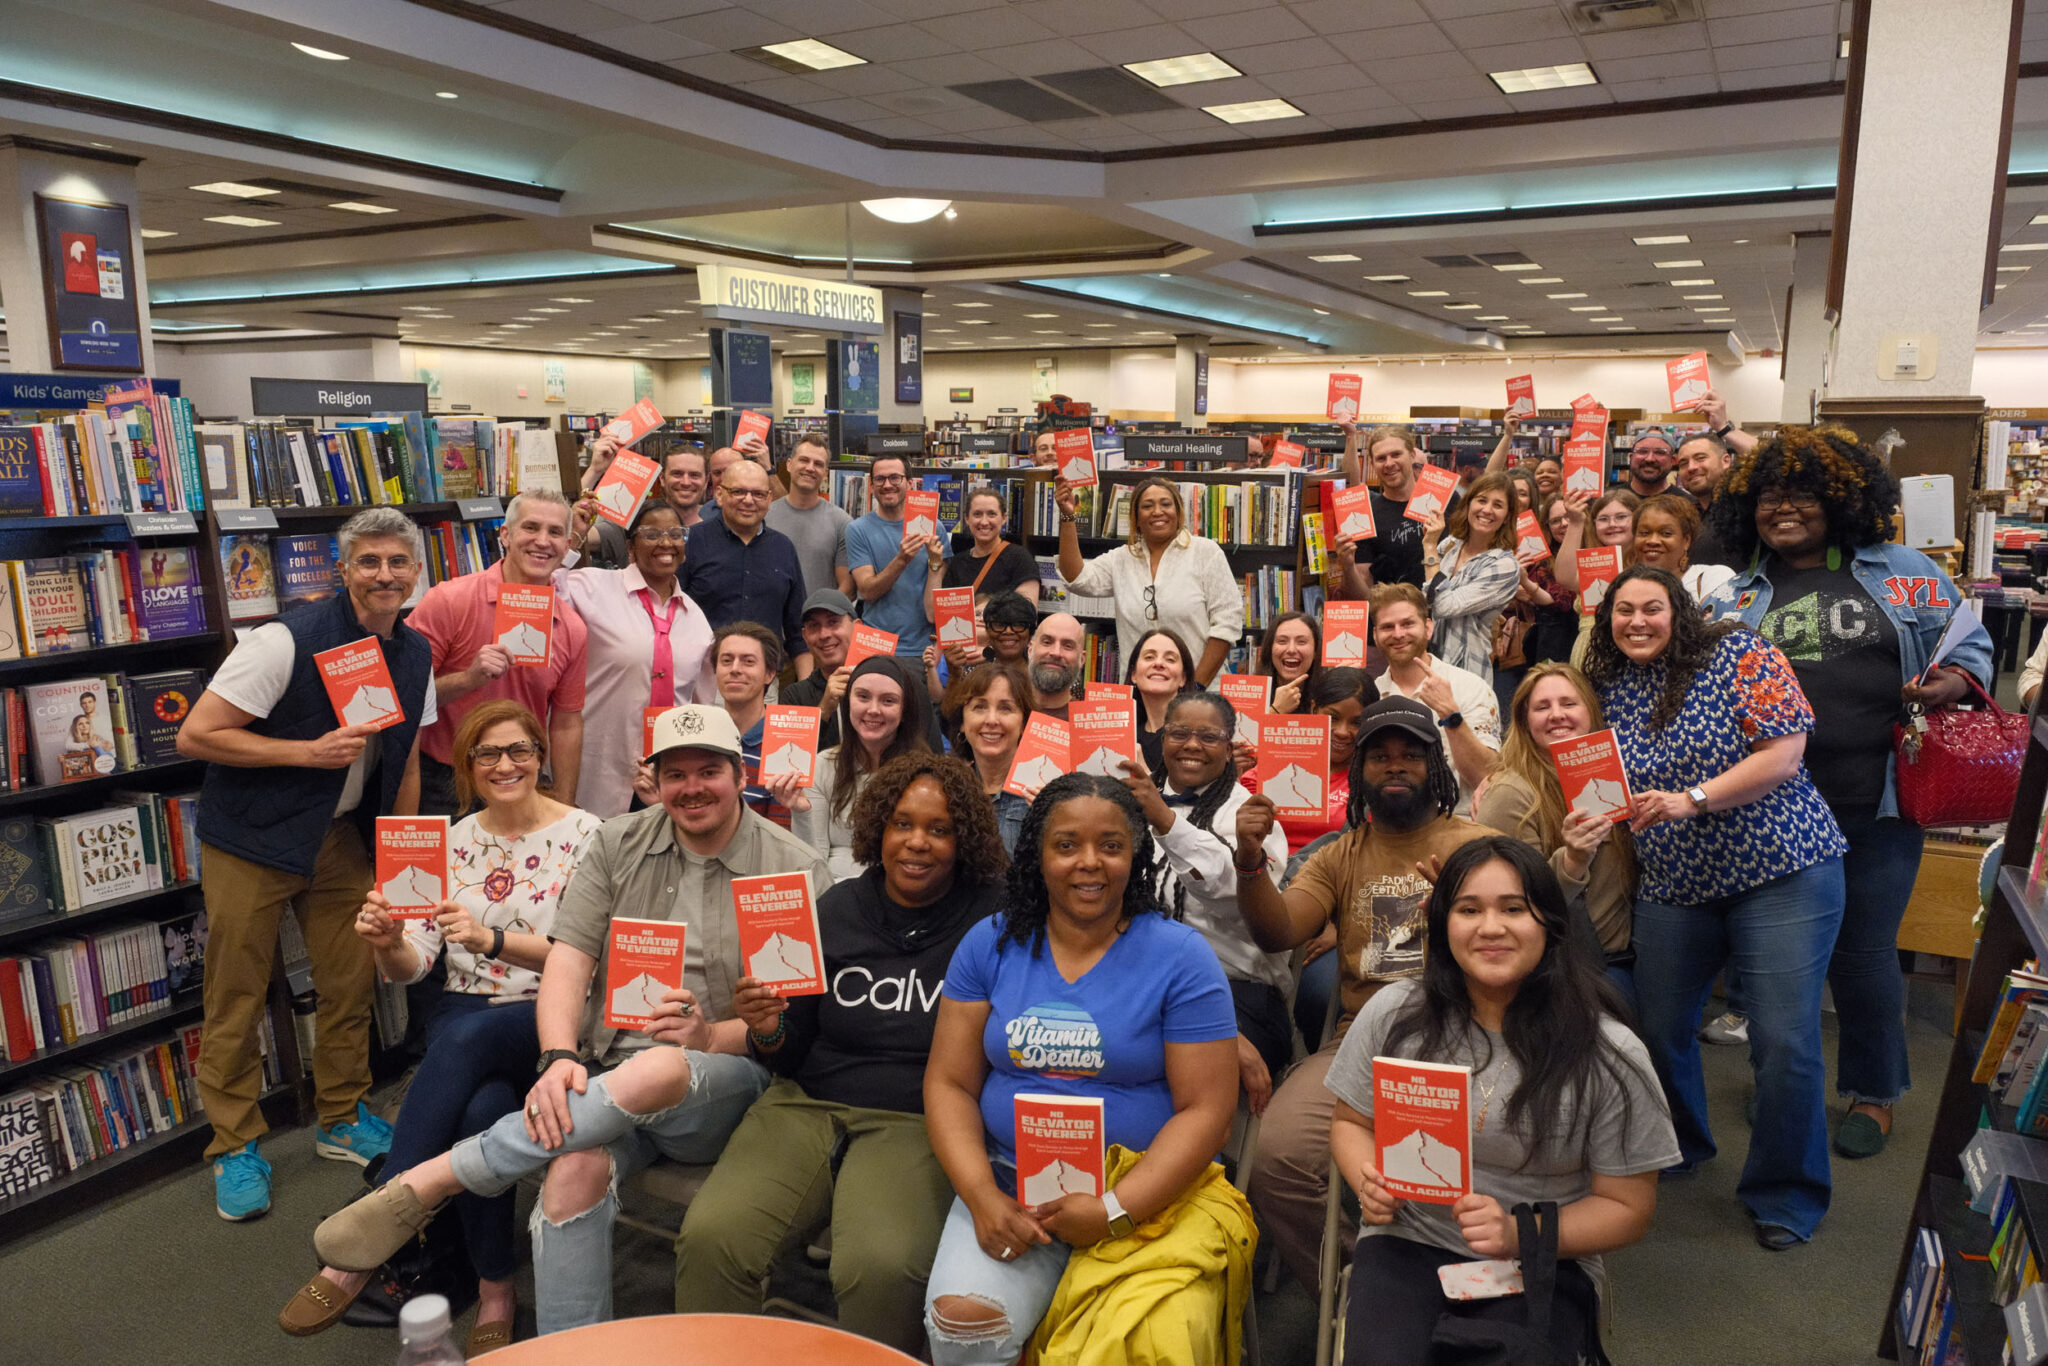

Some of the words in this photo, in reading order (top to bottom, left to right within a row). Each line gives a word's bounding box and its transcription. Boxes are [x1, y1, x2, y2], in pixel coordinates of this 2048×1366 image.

[729, 276, 809, 315] CUSTOMER
[814, 289, 875, 323] SERVICES
[13, 384, 49, 398] Kids'
[52, 386, 103, 400] Games
[317, 390, 372, 408] Religion
[1991, 410, 2028, 418] ADERS
[883, 439, 909, 447] Cookbooks
[1148, 443, 1183, 453] Natural
[1186, 444, 1223, 456] Healing
[940, 512, 958, 520] SLEEP
[292, 541, 318, 552] VOICE
[289, 556, 307, 568] FOR
[308, 555, 324, 566] THE
[55, 576, 73, 584] LIFE
[286, 570, 332, 584] VOICELESS
[50, 585, 74, 593] YOUR
[150, 586, 188, 602] LOVE
[1884, 576, 1950, 608] JYL
[152, 598, 190, 608] LANGUAGES
[502, 593, 550, 603] ELEVATOR
[31, 605, 78, 617] HILDREN
[509, 600, 549, 610] EVEREST
[856, 632, 894, 647] ELEVATOR
[324, 649, 378, 672] ELEVATOR
[328, 669, 340, 678] TO
[338, 656, 380, 675] EVEREST
[37, 683, 100, 698] COUNTING
[1222, 684, 1264, 692] ELEVATOR
[1088, 690, 1127, 700] ELEVATOR
[1230, 691, 1262, 699] EVEREST
[36, 702, 75, 716] COST
[770, 714, 816, 723] ELEVATOR
[1074, 711, 1130, 722] ELEVATOR
[150, 726, 178, 736] HABITS
[777, 722, 815, 730] EVEREST
[1031, 721, 1070, 740] ELEVATO
[1084, 720, 1129, 730] EVEREST
[1264, 726, 1324, 736] ELEVATOR
[1037, 731, 1070, 747] EVERES
[1274, 736, 1324, 745] EVEREST
[1558, 740, 1611, 760] ELEVATOR
[1570, 750, 1613, 767] EVEREST
[77, 820, 136, 848] GOS
[380, 831, 440, 840] ELEVATOR
[392, 840, 440, 848] EVEREST
[80, 841, 139, 870] PEL
[84, 859, 142, 888] MOM
[1382, 873, 1415, 886] FADING
[738, 888, 802, 904] ELEVATOR
[740, 904, 751, 912] TO
[752, 900, 804, 913] EVEREST
[616, 934, 679, 947] ELEVATOR
[626, 944, 678, 957] EVEREST
[171, 952, 204, 968] WORL
[781, 980, 818, 990] ACUFF
[833, 966, 944, 1012] Calv
[611, 1016, 636, 1025] WILL
[1005, 1016, 1101, 1048] Vitamin
[1020, 1044, 1105, 1069] Dealer
[1411, 1076, 1426, 1084] NO
[1380, 1078, 1460, 1100] ELEVATOR
[1381, 1090, 1394, 1100] TO
[1394, 1092, 1460, 1110] EVEREST
[1021, 1115, 1094, 1130] ELEVATOR
[1022, 1126, 1034, 1134] TO
[1034, 1128, 1095, 1140] EVEREST
[1385, 1181, 1416, 1194] WILL
[1416, 1186, 1463, 1198] ACUFF
[2017, 1301, 2030, 1337] Christian
[2024, 1333, 2038, 1362] Living
